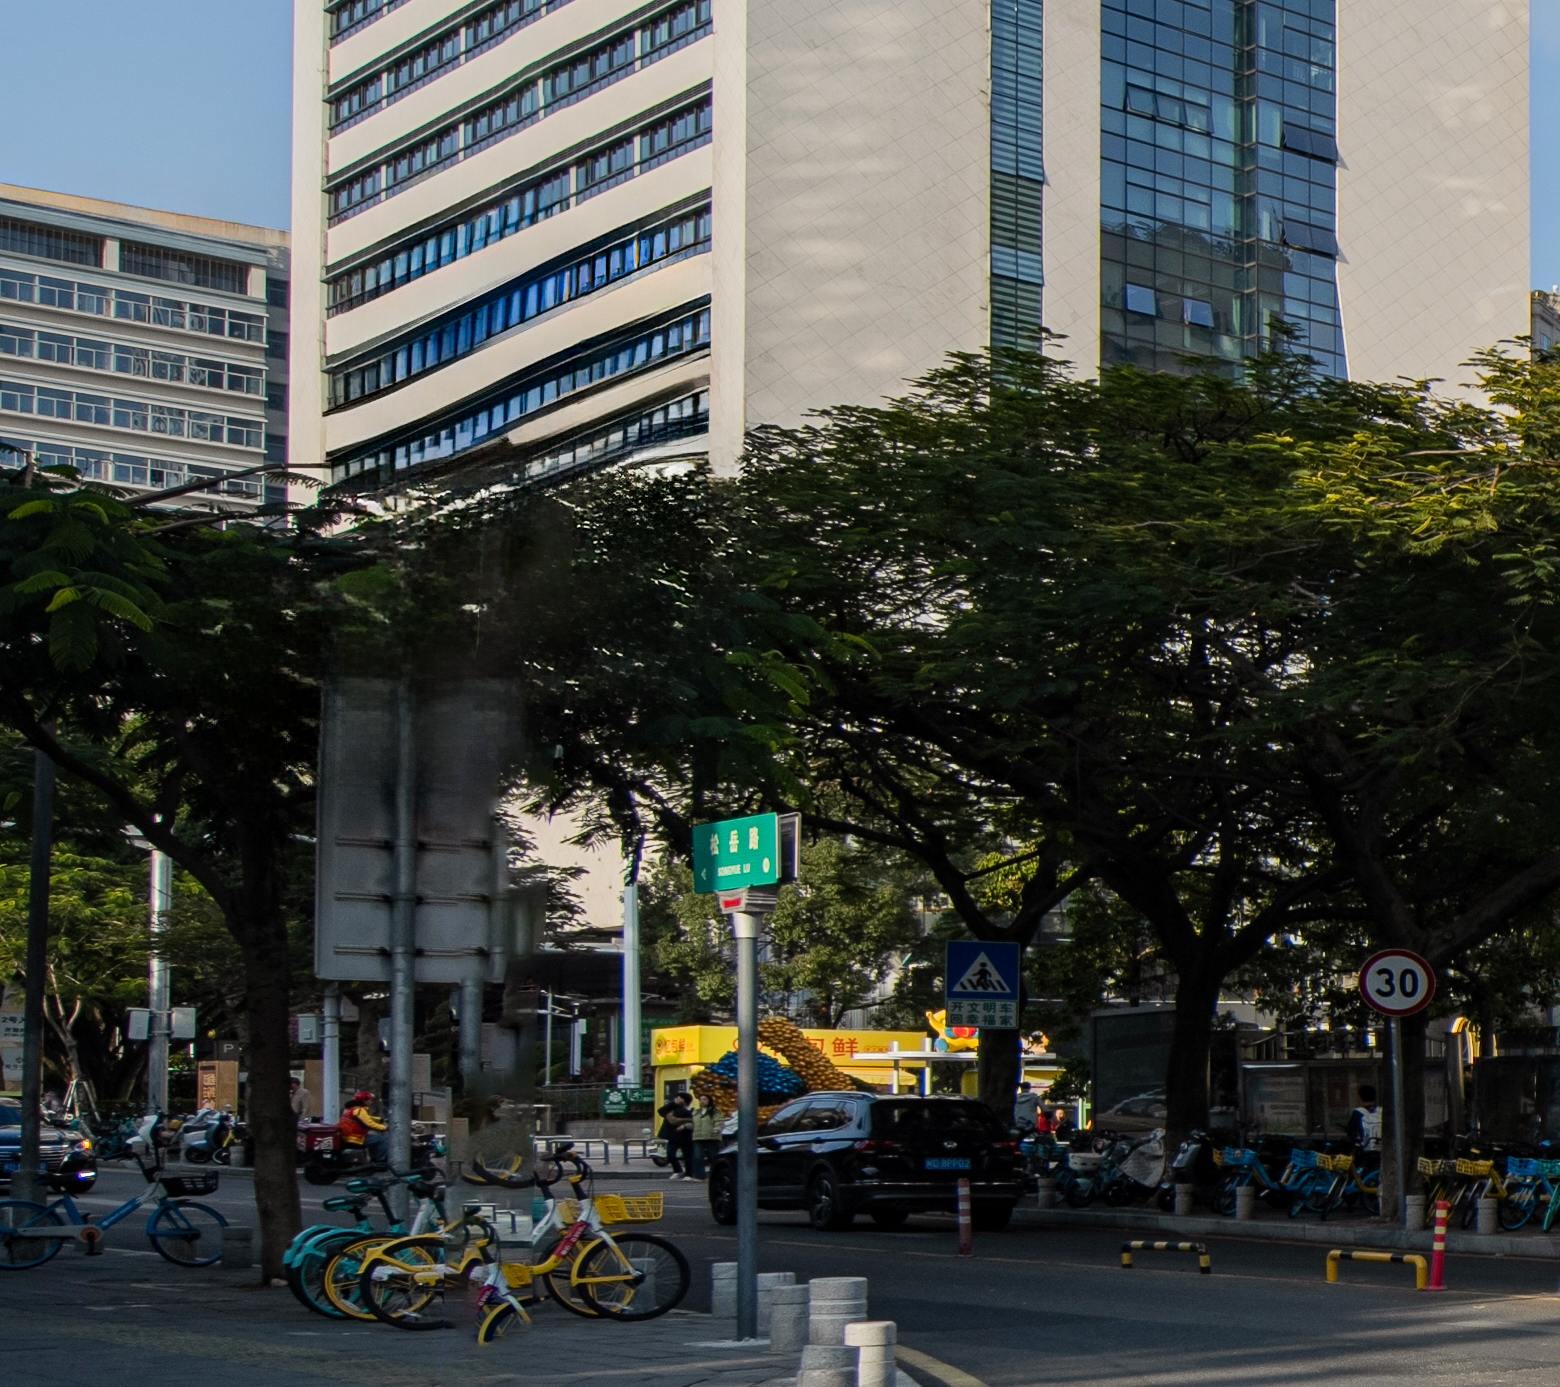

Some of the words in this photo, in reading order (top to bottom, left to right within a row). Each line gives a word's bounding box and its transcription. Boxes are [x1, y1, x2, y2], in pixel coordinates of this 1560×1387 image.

[709, 826, 759, 856] 松岳路
[717, 864, 742, 877] SONGYUE
[743, 862, 751, 874] LU
[1375, 967, 1419, 998] 30
[950, 1001, 1013, 1014] 开文明车
[950, 1013, 1013, 1027] 回幸福家
[223, 1043, 234, 1054] P
